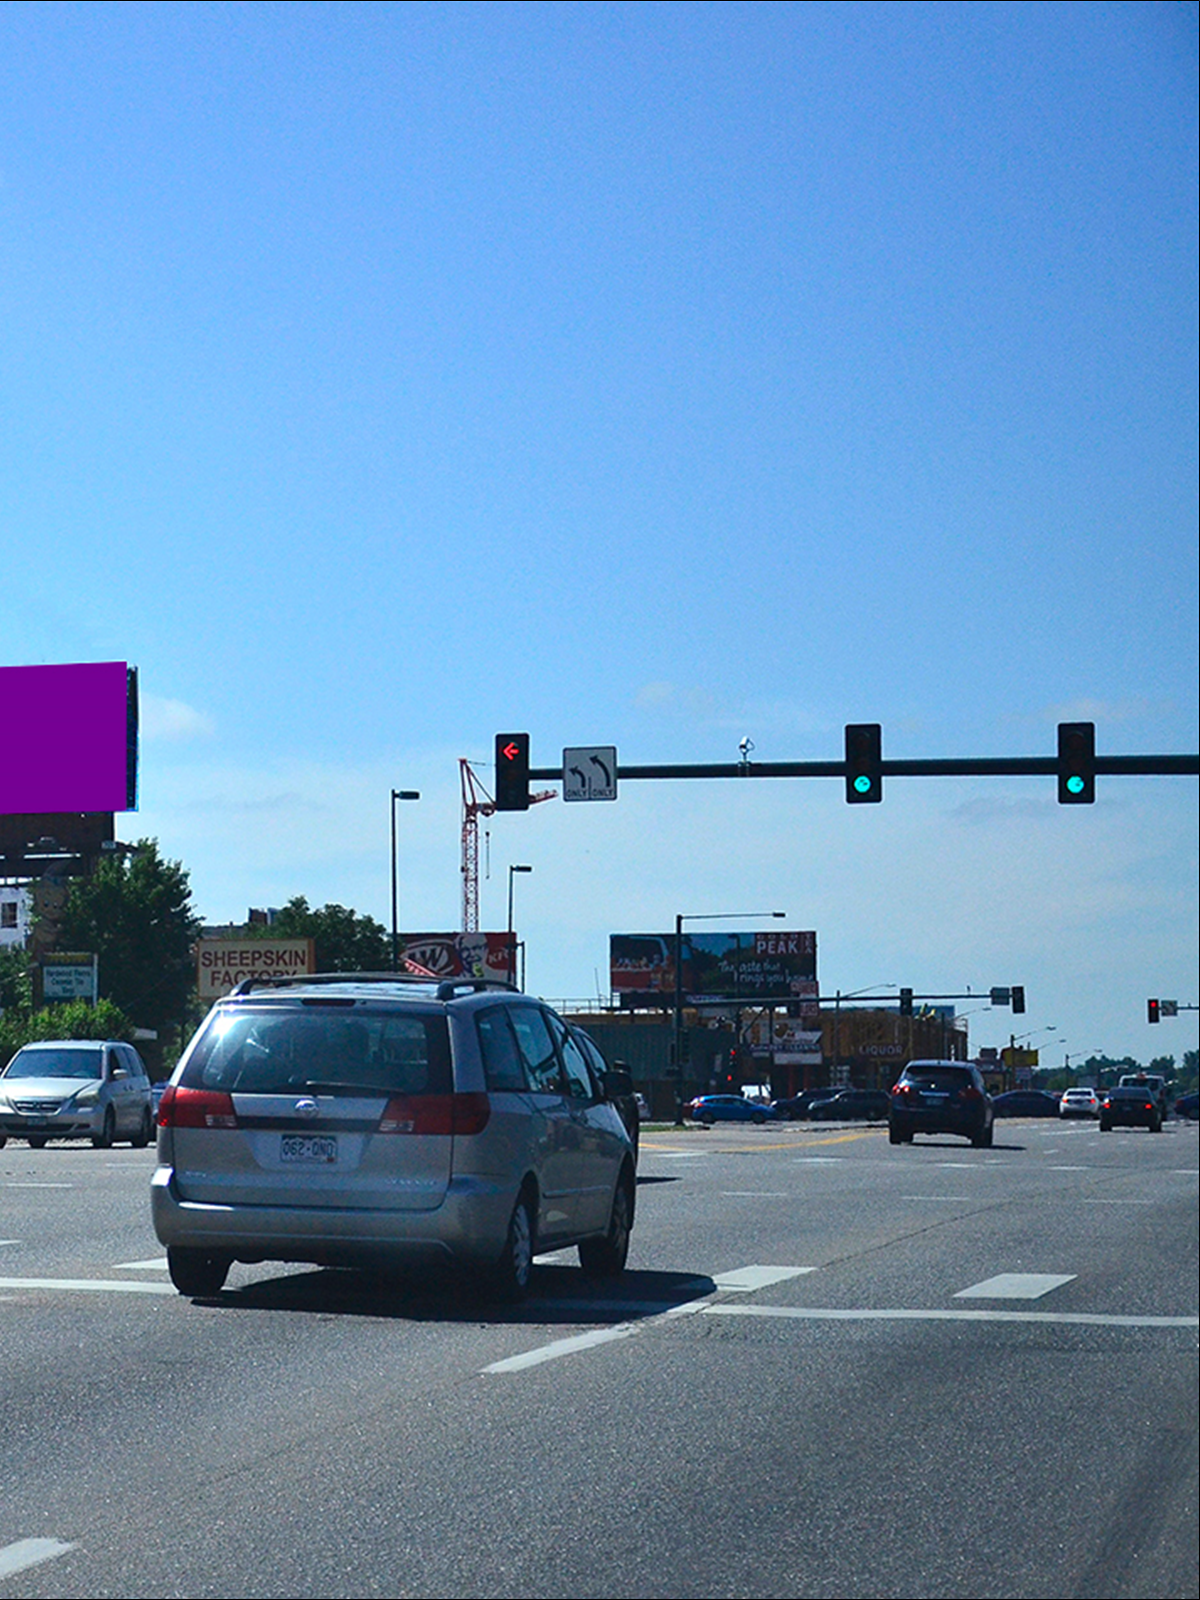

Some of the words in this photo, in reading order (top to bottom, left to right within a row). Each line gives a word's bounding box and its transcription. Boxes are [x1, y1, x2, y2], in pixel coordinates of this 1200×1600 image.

[566, 789, 588, 798] ONLY
[591, 788, 613, 797] ONLY
[756, 940, 799, 955] PEAK
[201, 949, 307, 968] SHEEPSKIN
[858, 1044, 903, 1056] LIQUOR
